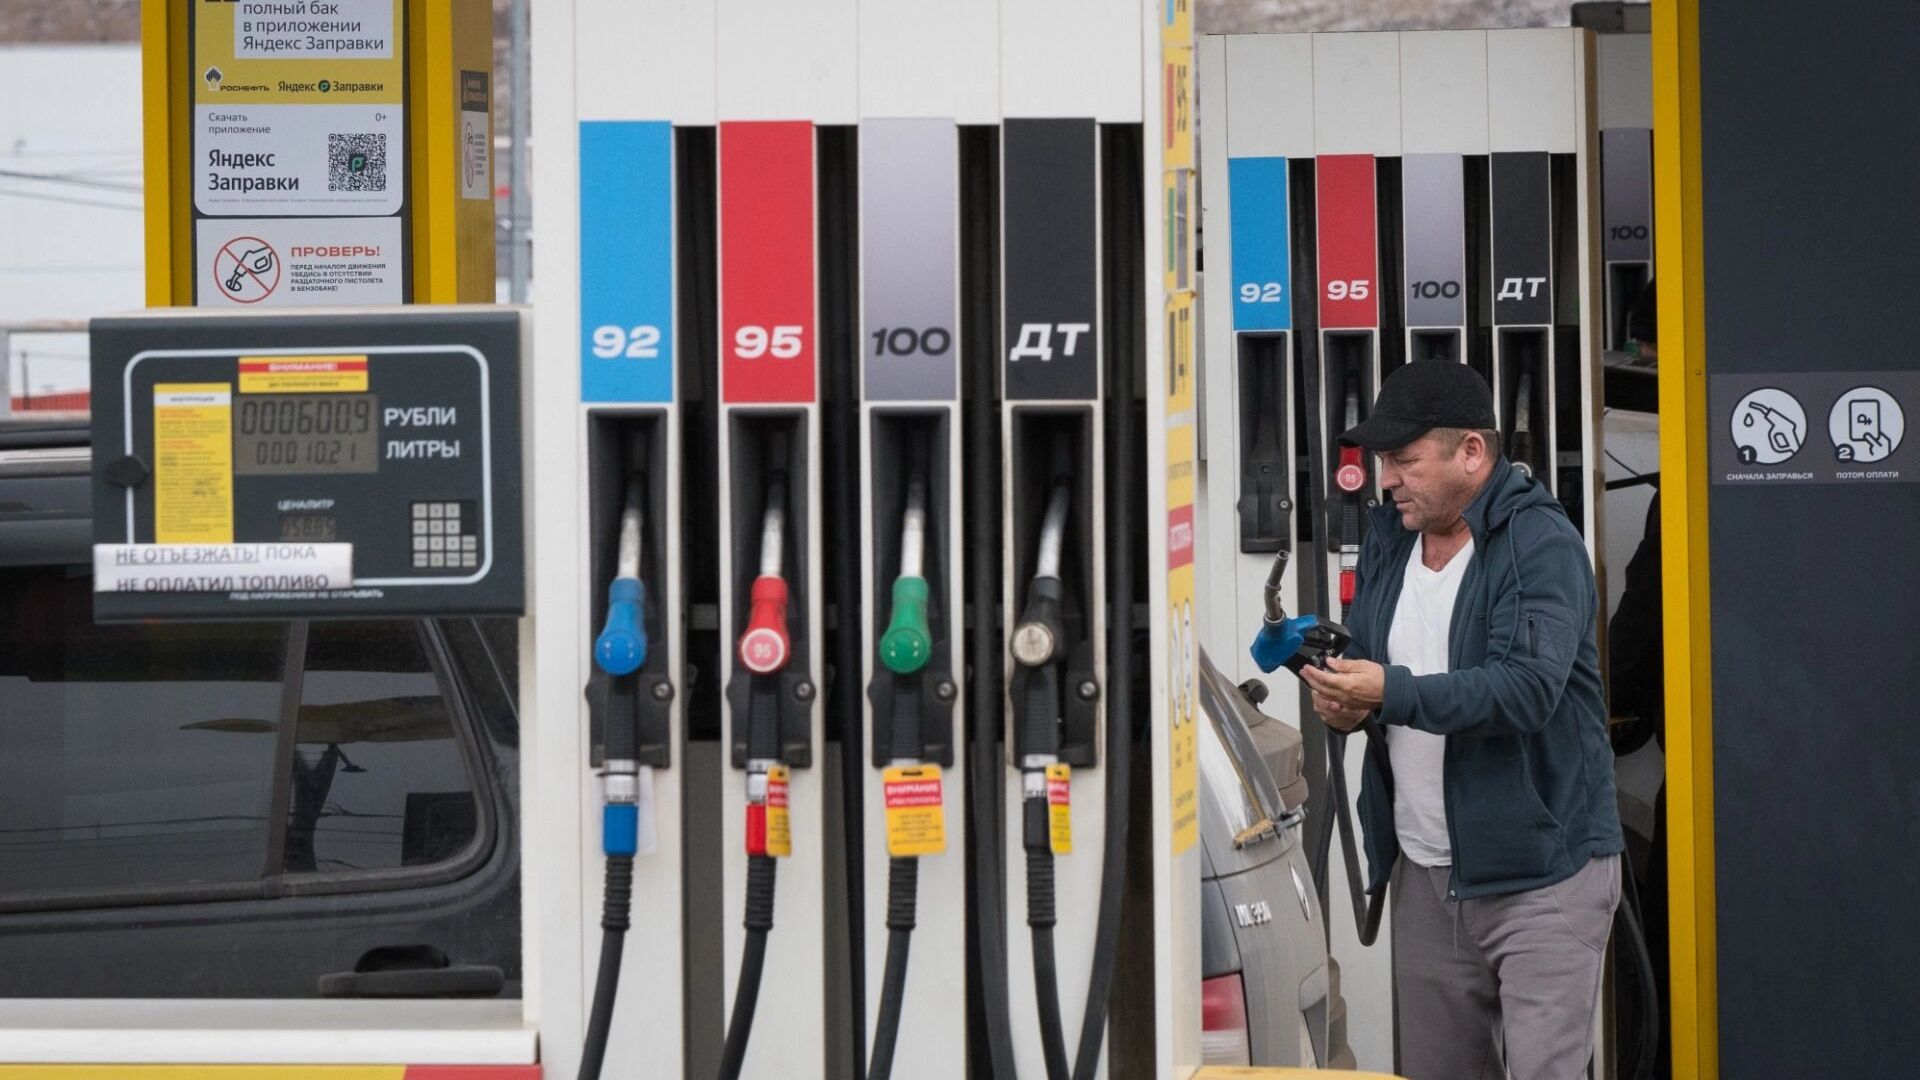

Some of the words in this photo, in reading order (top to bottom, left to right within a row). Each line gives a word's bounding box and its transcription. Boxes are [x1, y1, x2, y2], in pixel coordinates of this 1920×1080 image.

[243, 1, 305, 15] полный
[310, 1, 338, 15] бак
[243, 21, 252, 32] в
[256, 20, 361, 34] приложении
[243, 37, 302, 52] Яндекс
[306, 36, 384, 52] Заправки
[278, 81, 316, 93] Яндекс
[333, 81, 384, 93] Заправки
[208, 112, 248, 122] Скачать
[375, 113, 387, 122] 0+
[208, 126, 271, 135] приложение
[208, 150, 275, 169] Яндекс
[208, 173, 299, 193] Заправки
[1610, 225, 1648, 240] 100
[291, 246, 380, 257] ПРОВЕРЬ!
[1240, 283, 1282, 303] 92
[1327, 280, 1369, 301] 95
[1411, 280, 1461, 299] 100
[1497, 277, 1546, 301] ДТ
[592, 325, 661, 358] 92
[734, 324, 803, 359] 95
[872, 326, 951, 357] 100
[1010, 323, 1090, 362] ДТ
[384, 406, 457, 427] РУБЛИ
[386, 440, 460, 459] ЛИТРЫ
[1742, 449, 1751, 461] 1
[1838, 448, 1851, 460] 2
[1345, 473, 1357, 483] 95
[1726, 472, 1764, 480] СНАЧАЛА
[1765, 472, 1814, 480] ЗАПРАВЬСЯ
[1836, 471, 1865, 479] ПОТОМ
[1866, 471, 1899, 479] ОПЛАТИ
[116, 548, 138, 563] НЕ
[144, 546, 259, 564] ОТЪЕЗЖАТЬ!
[266, 545, 316, 560] ПОКА
[117, 577, 138, 591] НЕ
[145, 576, 233, 591] ОПЛАТИЛ
[240, 574, 329, 590] ТОПЛИВО
[755, 643, 771, 658] 95
